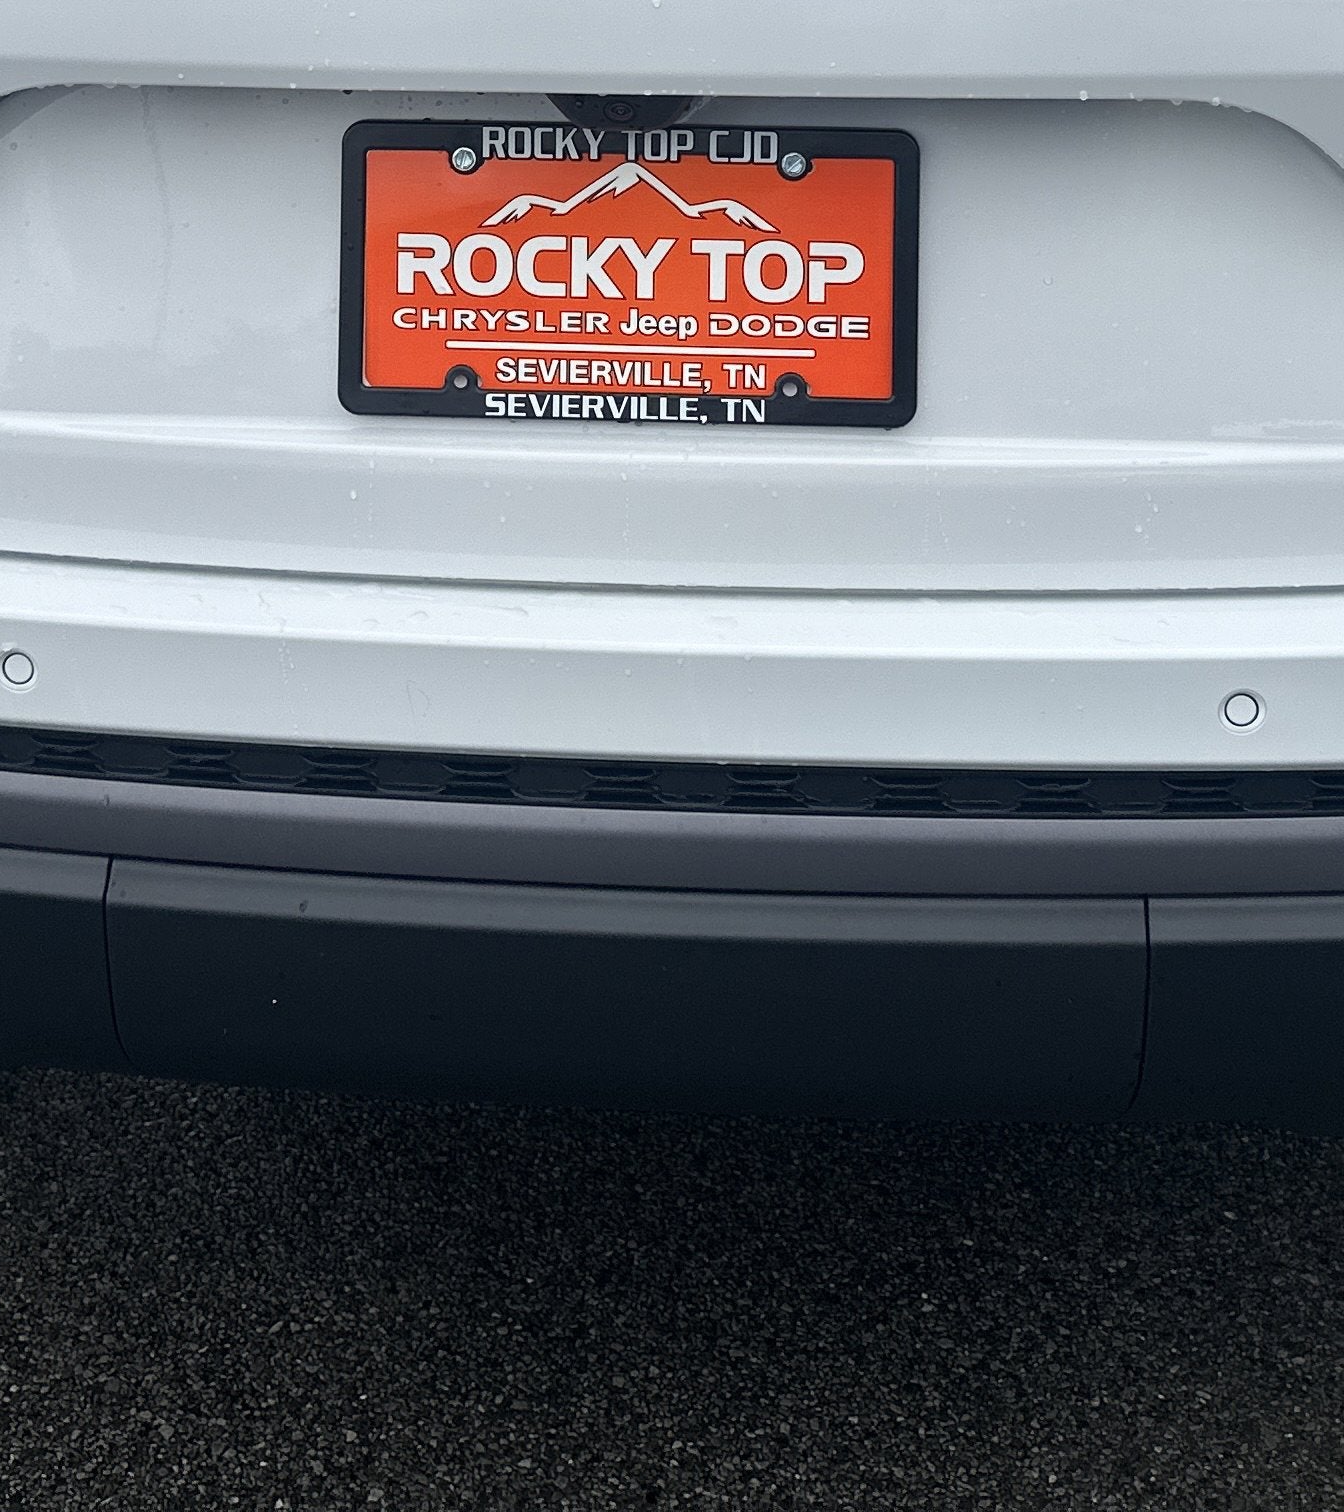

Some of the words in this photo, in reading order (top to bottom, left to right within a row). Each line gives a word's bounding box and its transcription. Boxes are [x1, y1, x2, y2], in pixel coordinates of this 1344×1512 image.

[482, 126, 605, 162] ROCKY
[621, 129, 694, 164] TOP
[709, 130, 779, 166] CJD
[396, 232, 679, 300] ROCKY
[690, 238, 866, 305] TOP
[393, 306, 611, 335] CHRYSLER
[618, 307, 699, 340] Jeep
[709, 313, 871, 340] DODGE
[495, 357, 712, 392] SEVIERVILLE,
[723, 363, 768, 390] TN
[485, 394, 709, 424] SEVIERVILLE,
[720, 397, 767, 423] TN
